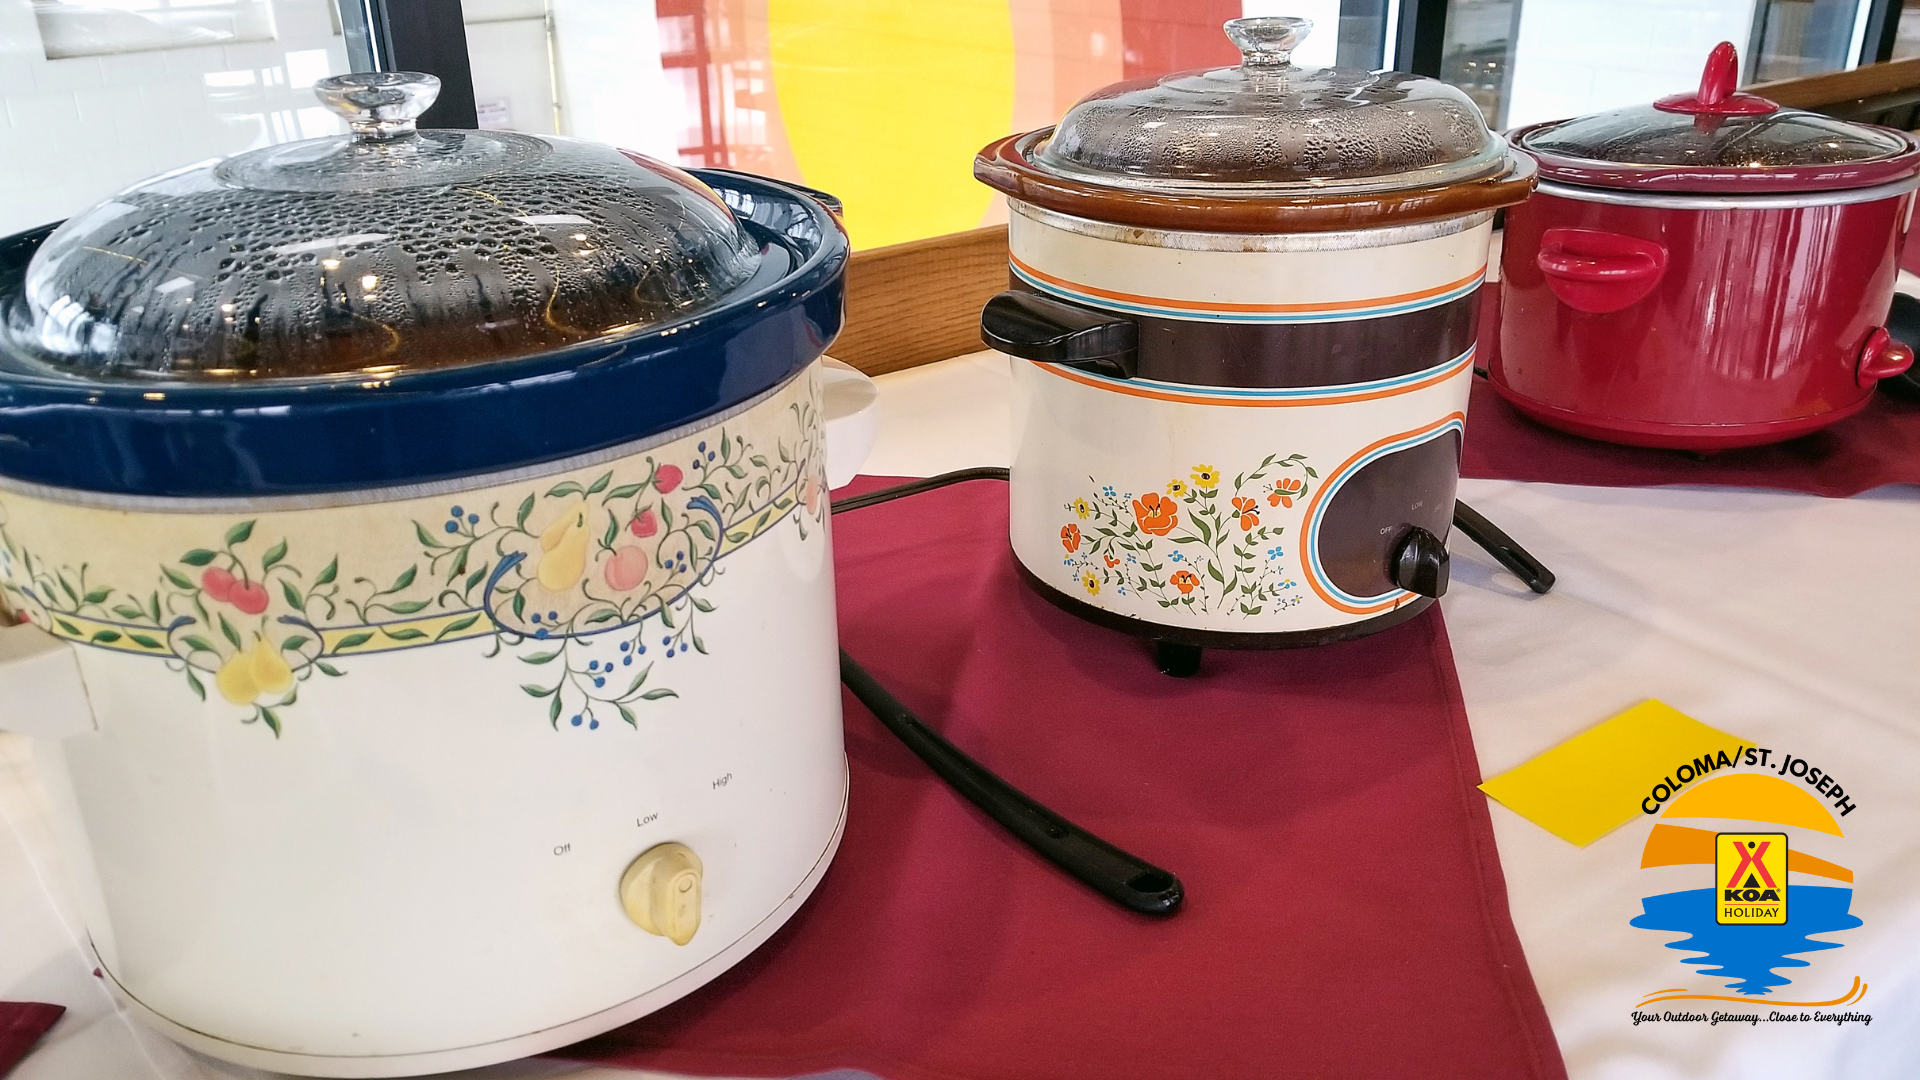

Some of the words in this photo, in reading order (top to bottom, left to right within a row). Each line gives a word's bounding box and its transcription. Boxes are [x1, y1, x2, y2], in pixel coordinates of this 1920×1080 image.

[1411, 501, 1423, 510] LOW
[1380, 526, 1392, 535] OFF
[712, 772, 733, 790] High
[636, 812, 658, 827] Low
[553, 843, 571, 856] Off
